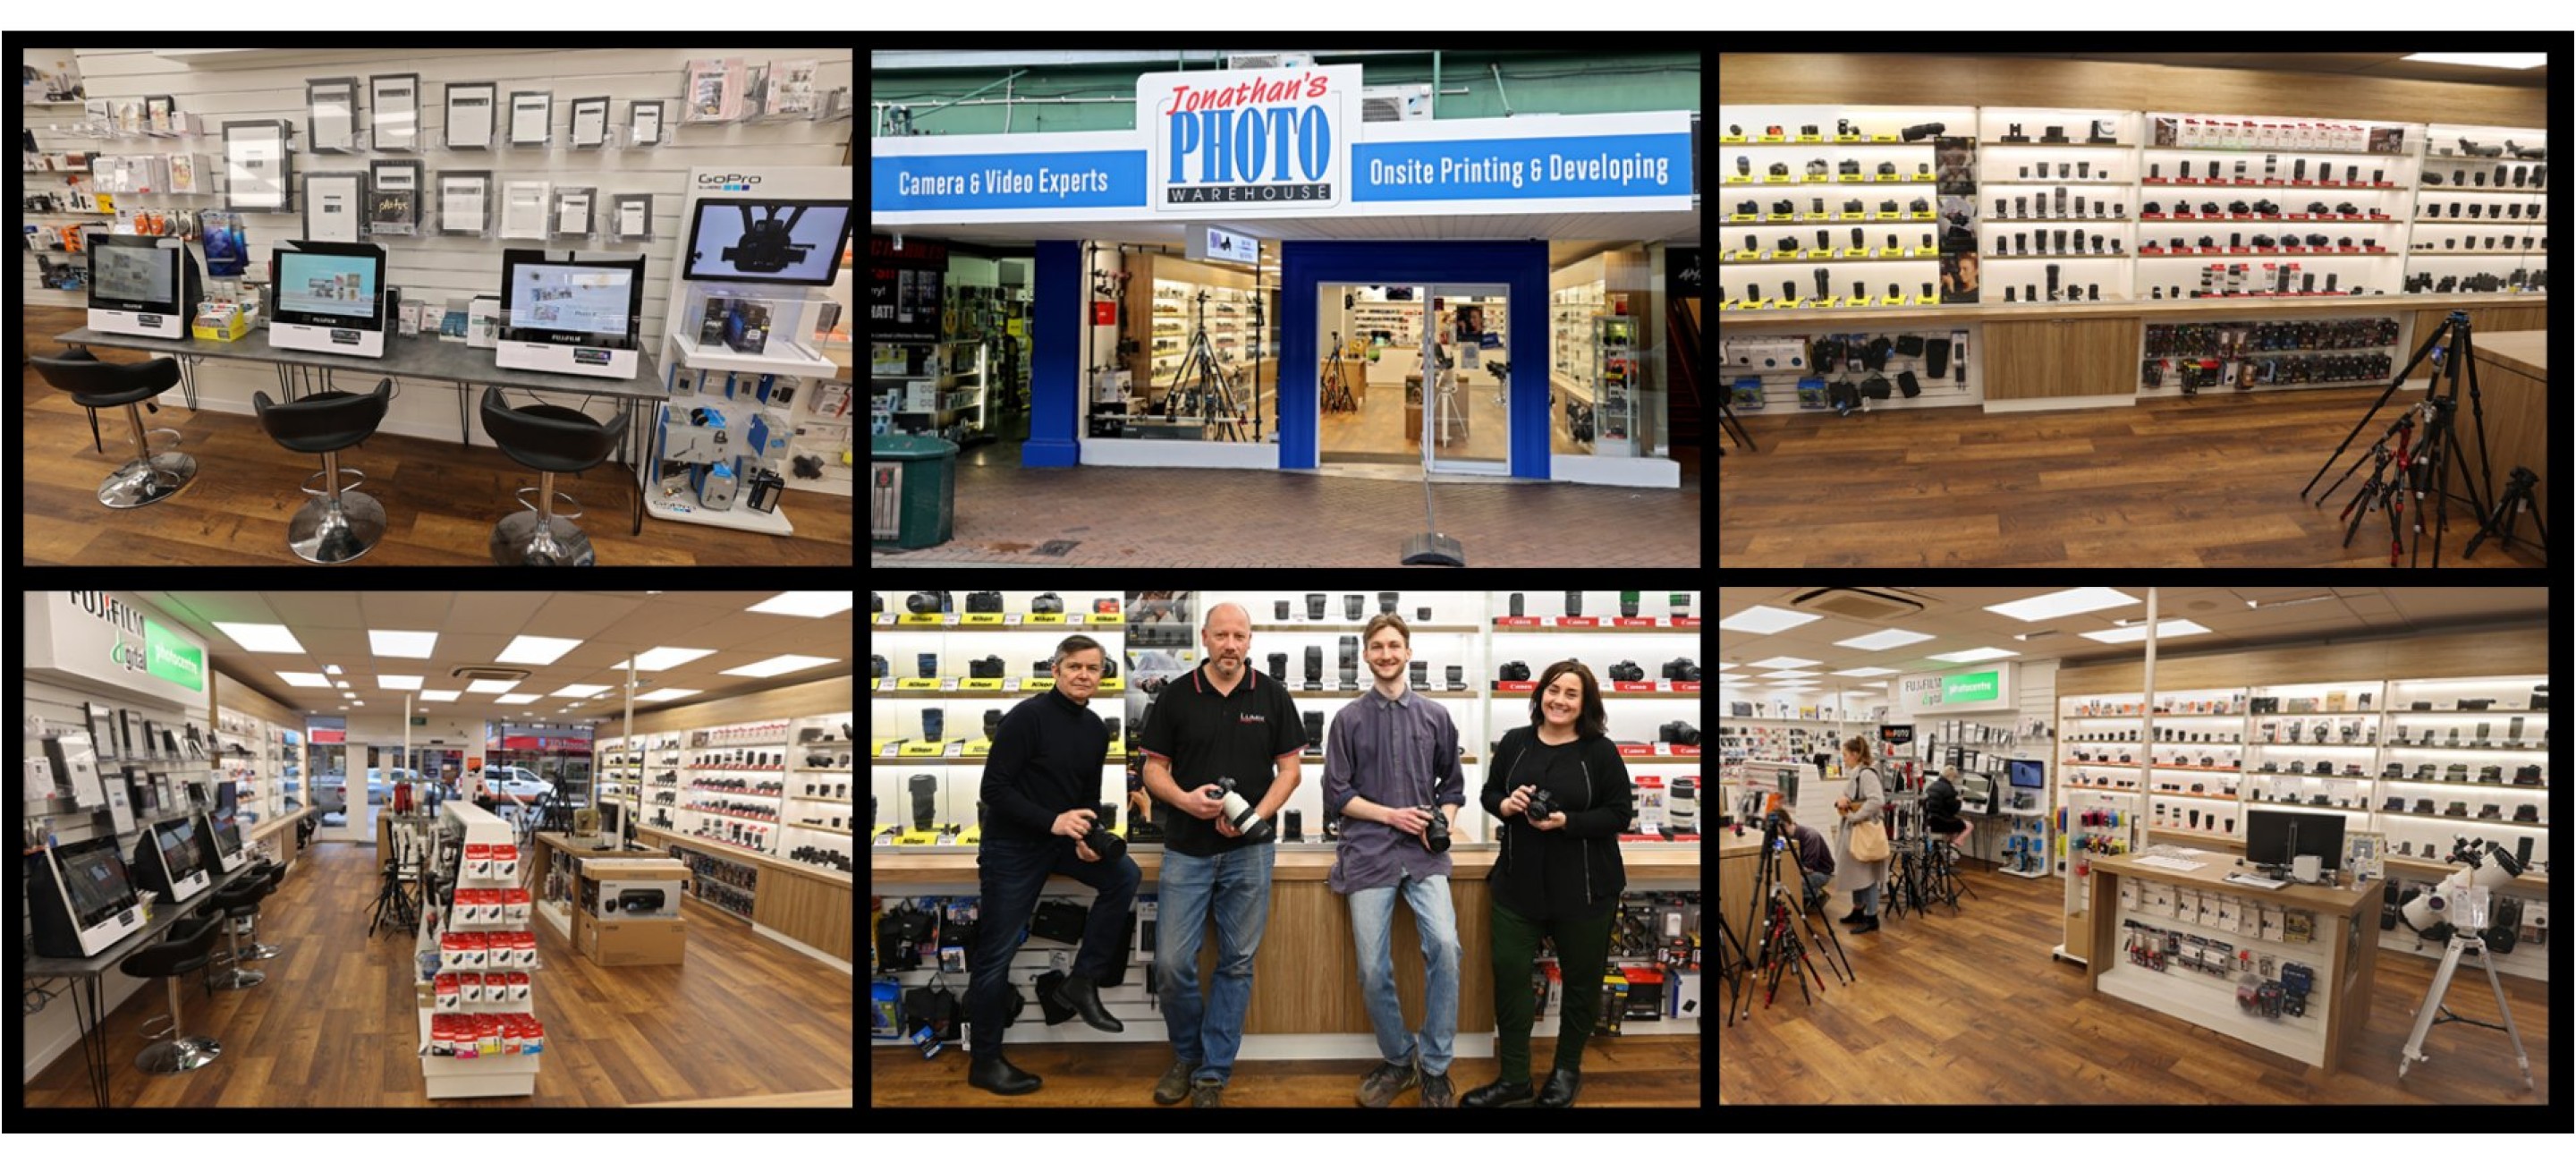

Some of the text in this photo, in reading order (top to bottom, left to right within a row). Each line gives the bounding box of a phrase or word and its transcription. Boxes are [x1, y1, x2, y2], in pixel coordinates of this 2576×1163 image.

[1165, 72, 1328, 115] Jonathan's
[1167, 105, 1331, 183] PHOTO
[698, 173, 762, 184] GoPro
[899, 167, 1108, 199] Camera & Video Experts
[1370, 153, 1669, 189] Onsite Printing & Developing
[1171, 185, 1326, 202] WAREHOUSE
